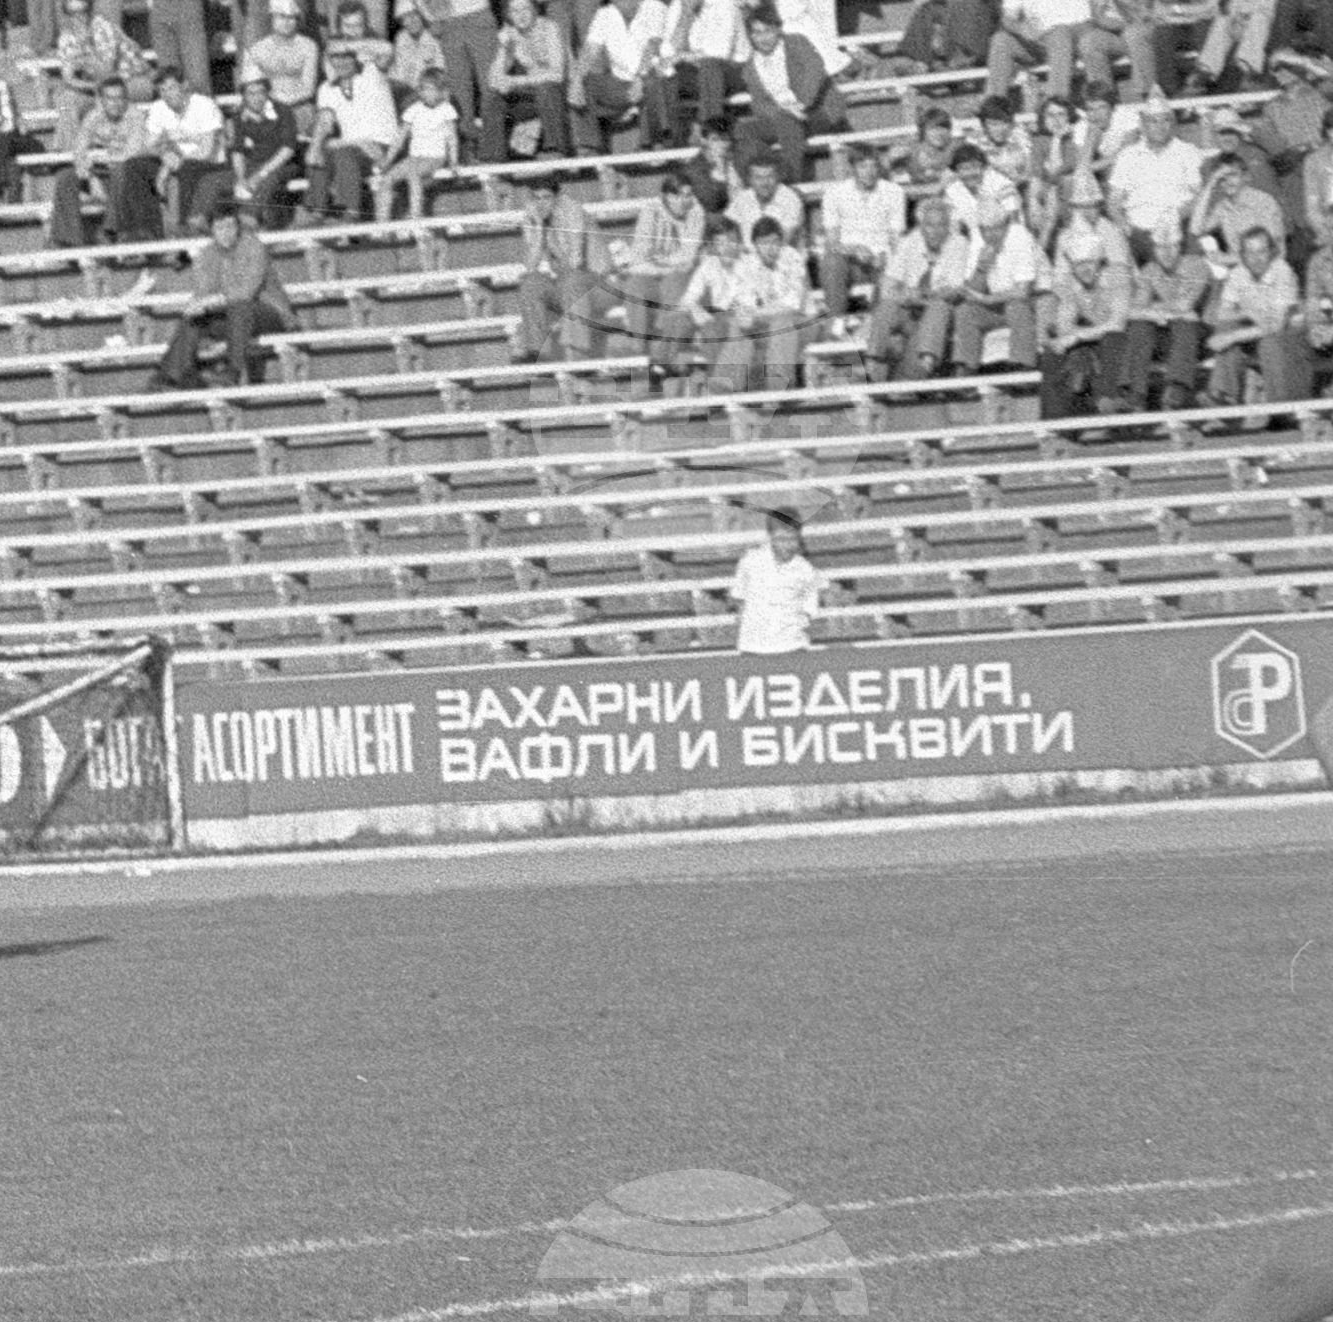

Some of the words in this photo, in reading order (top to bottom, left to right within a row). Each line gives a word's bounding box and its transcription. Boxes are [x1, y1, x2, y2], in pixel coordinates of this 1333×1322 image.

[435, 678, 702, 730] ЗАХАРНИ
[192, 702, 416, 784] АСОРТИМЕНТ
[439, 732, 656, 783] ВАФЛИ
[678, 729, 719, 769] И
[741, 710, 1075, 767] БИСКВИТИ
